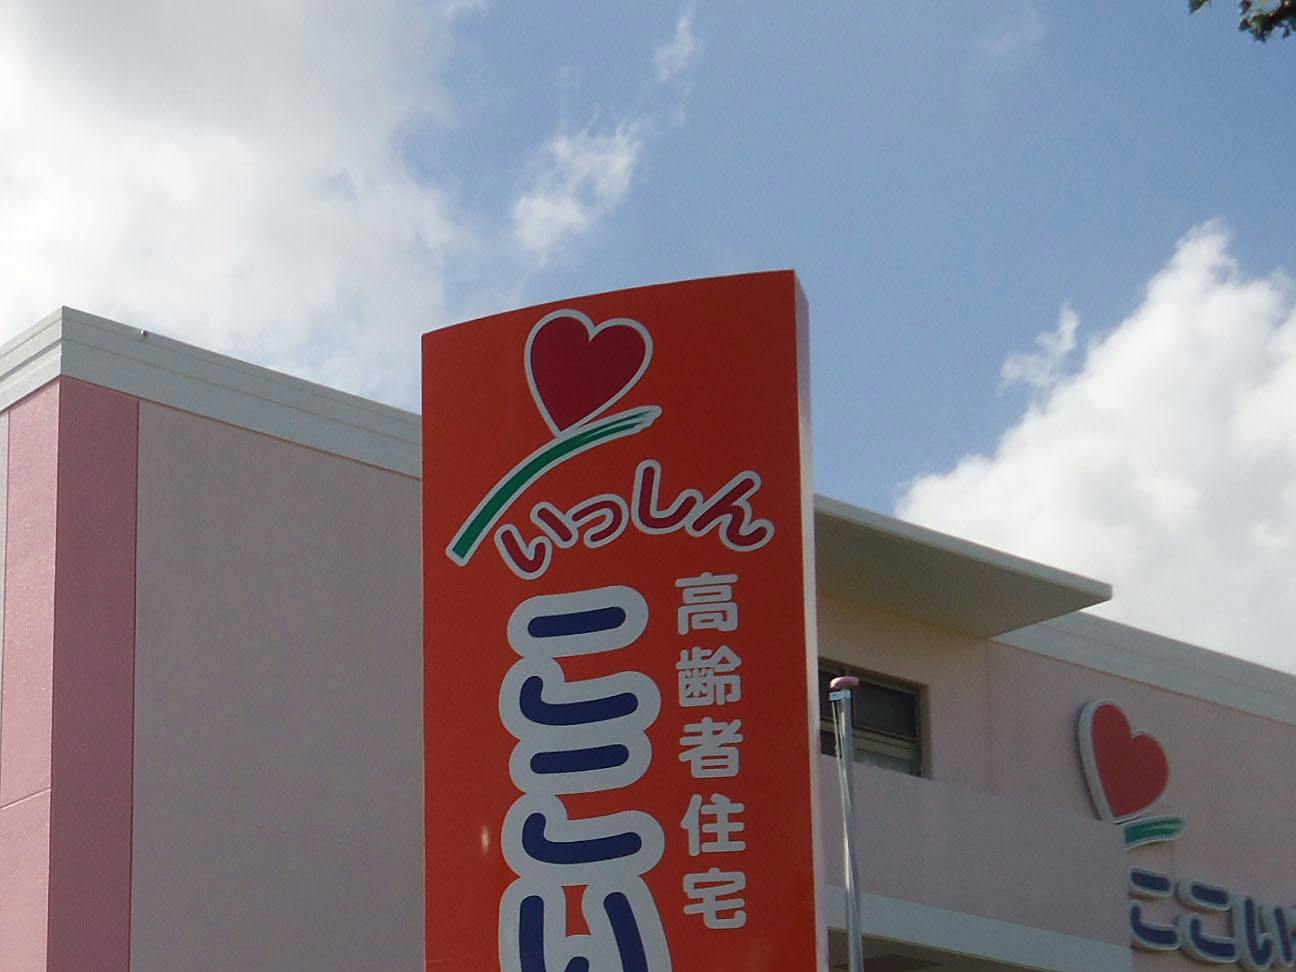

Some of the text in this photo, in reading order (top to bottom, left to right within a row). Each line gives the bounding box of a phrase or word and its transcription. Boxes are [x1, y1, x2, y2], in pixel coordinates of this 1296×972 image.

[494, 460, 774, 580] いっしん
[675, 571, 747, 930] 高齢者住宅
[1128, 866, 1296, 972] ここい
